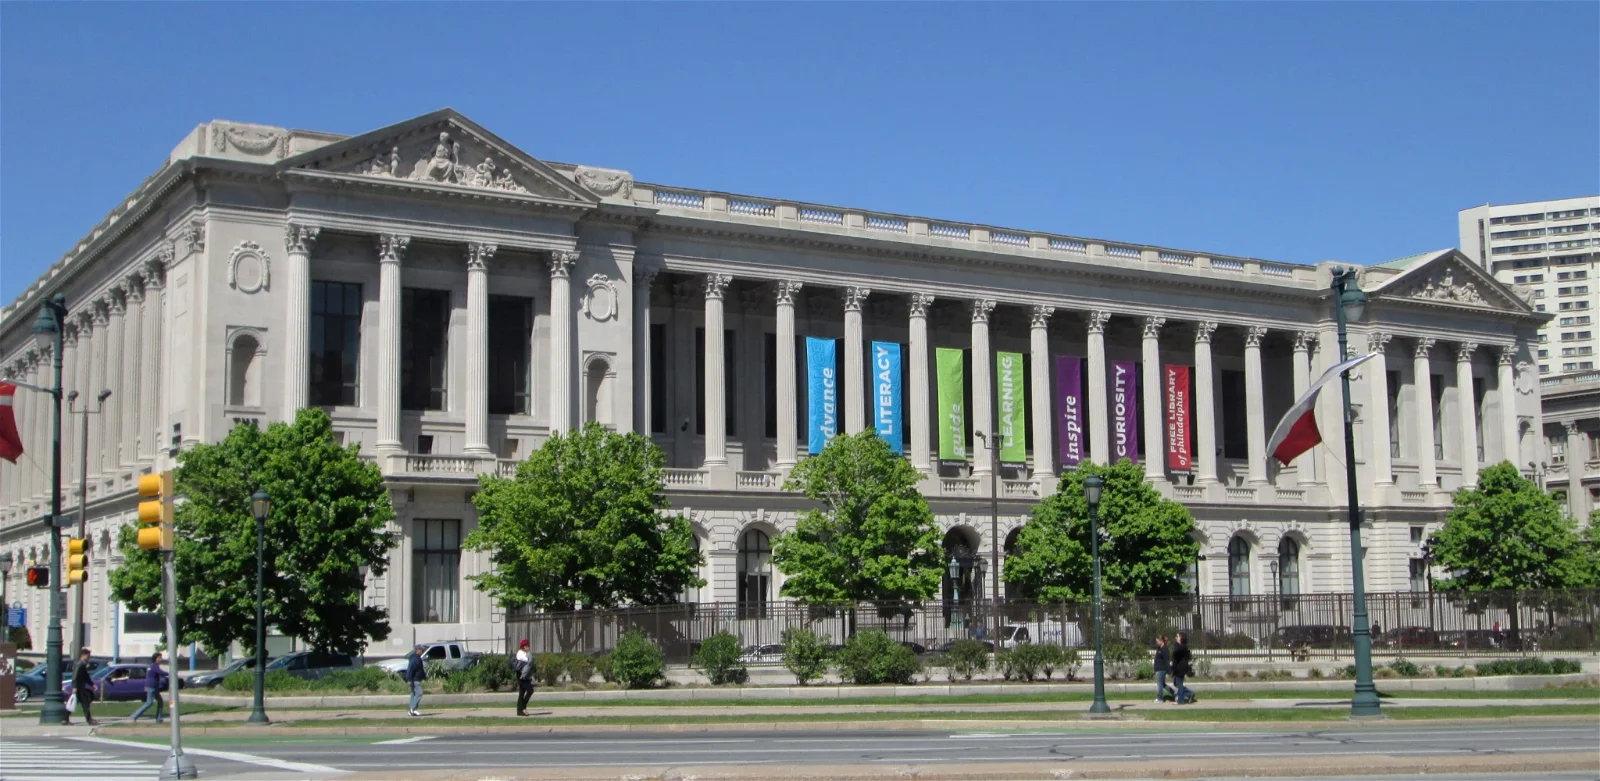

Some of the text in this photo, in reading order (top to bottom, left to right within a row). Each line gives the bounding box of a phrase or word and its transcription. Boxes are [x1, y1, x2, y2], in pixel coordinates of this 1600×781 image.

[876, 345, 893, 435] LITERACY
[1002, 356, 1014, 447] LEARNING
[1115, 365, 1127, 456] CURIOSITY
[1168, 369, 1177, 453] FREE LIBRARY
[1176, 391, 1187, 453] philadelphia
[950, 404, 966, 457] guide
[1064, 395, 1081, 461] inspire
[1178, 454, 1187, 466] of
